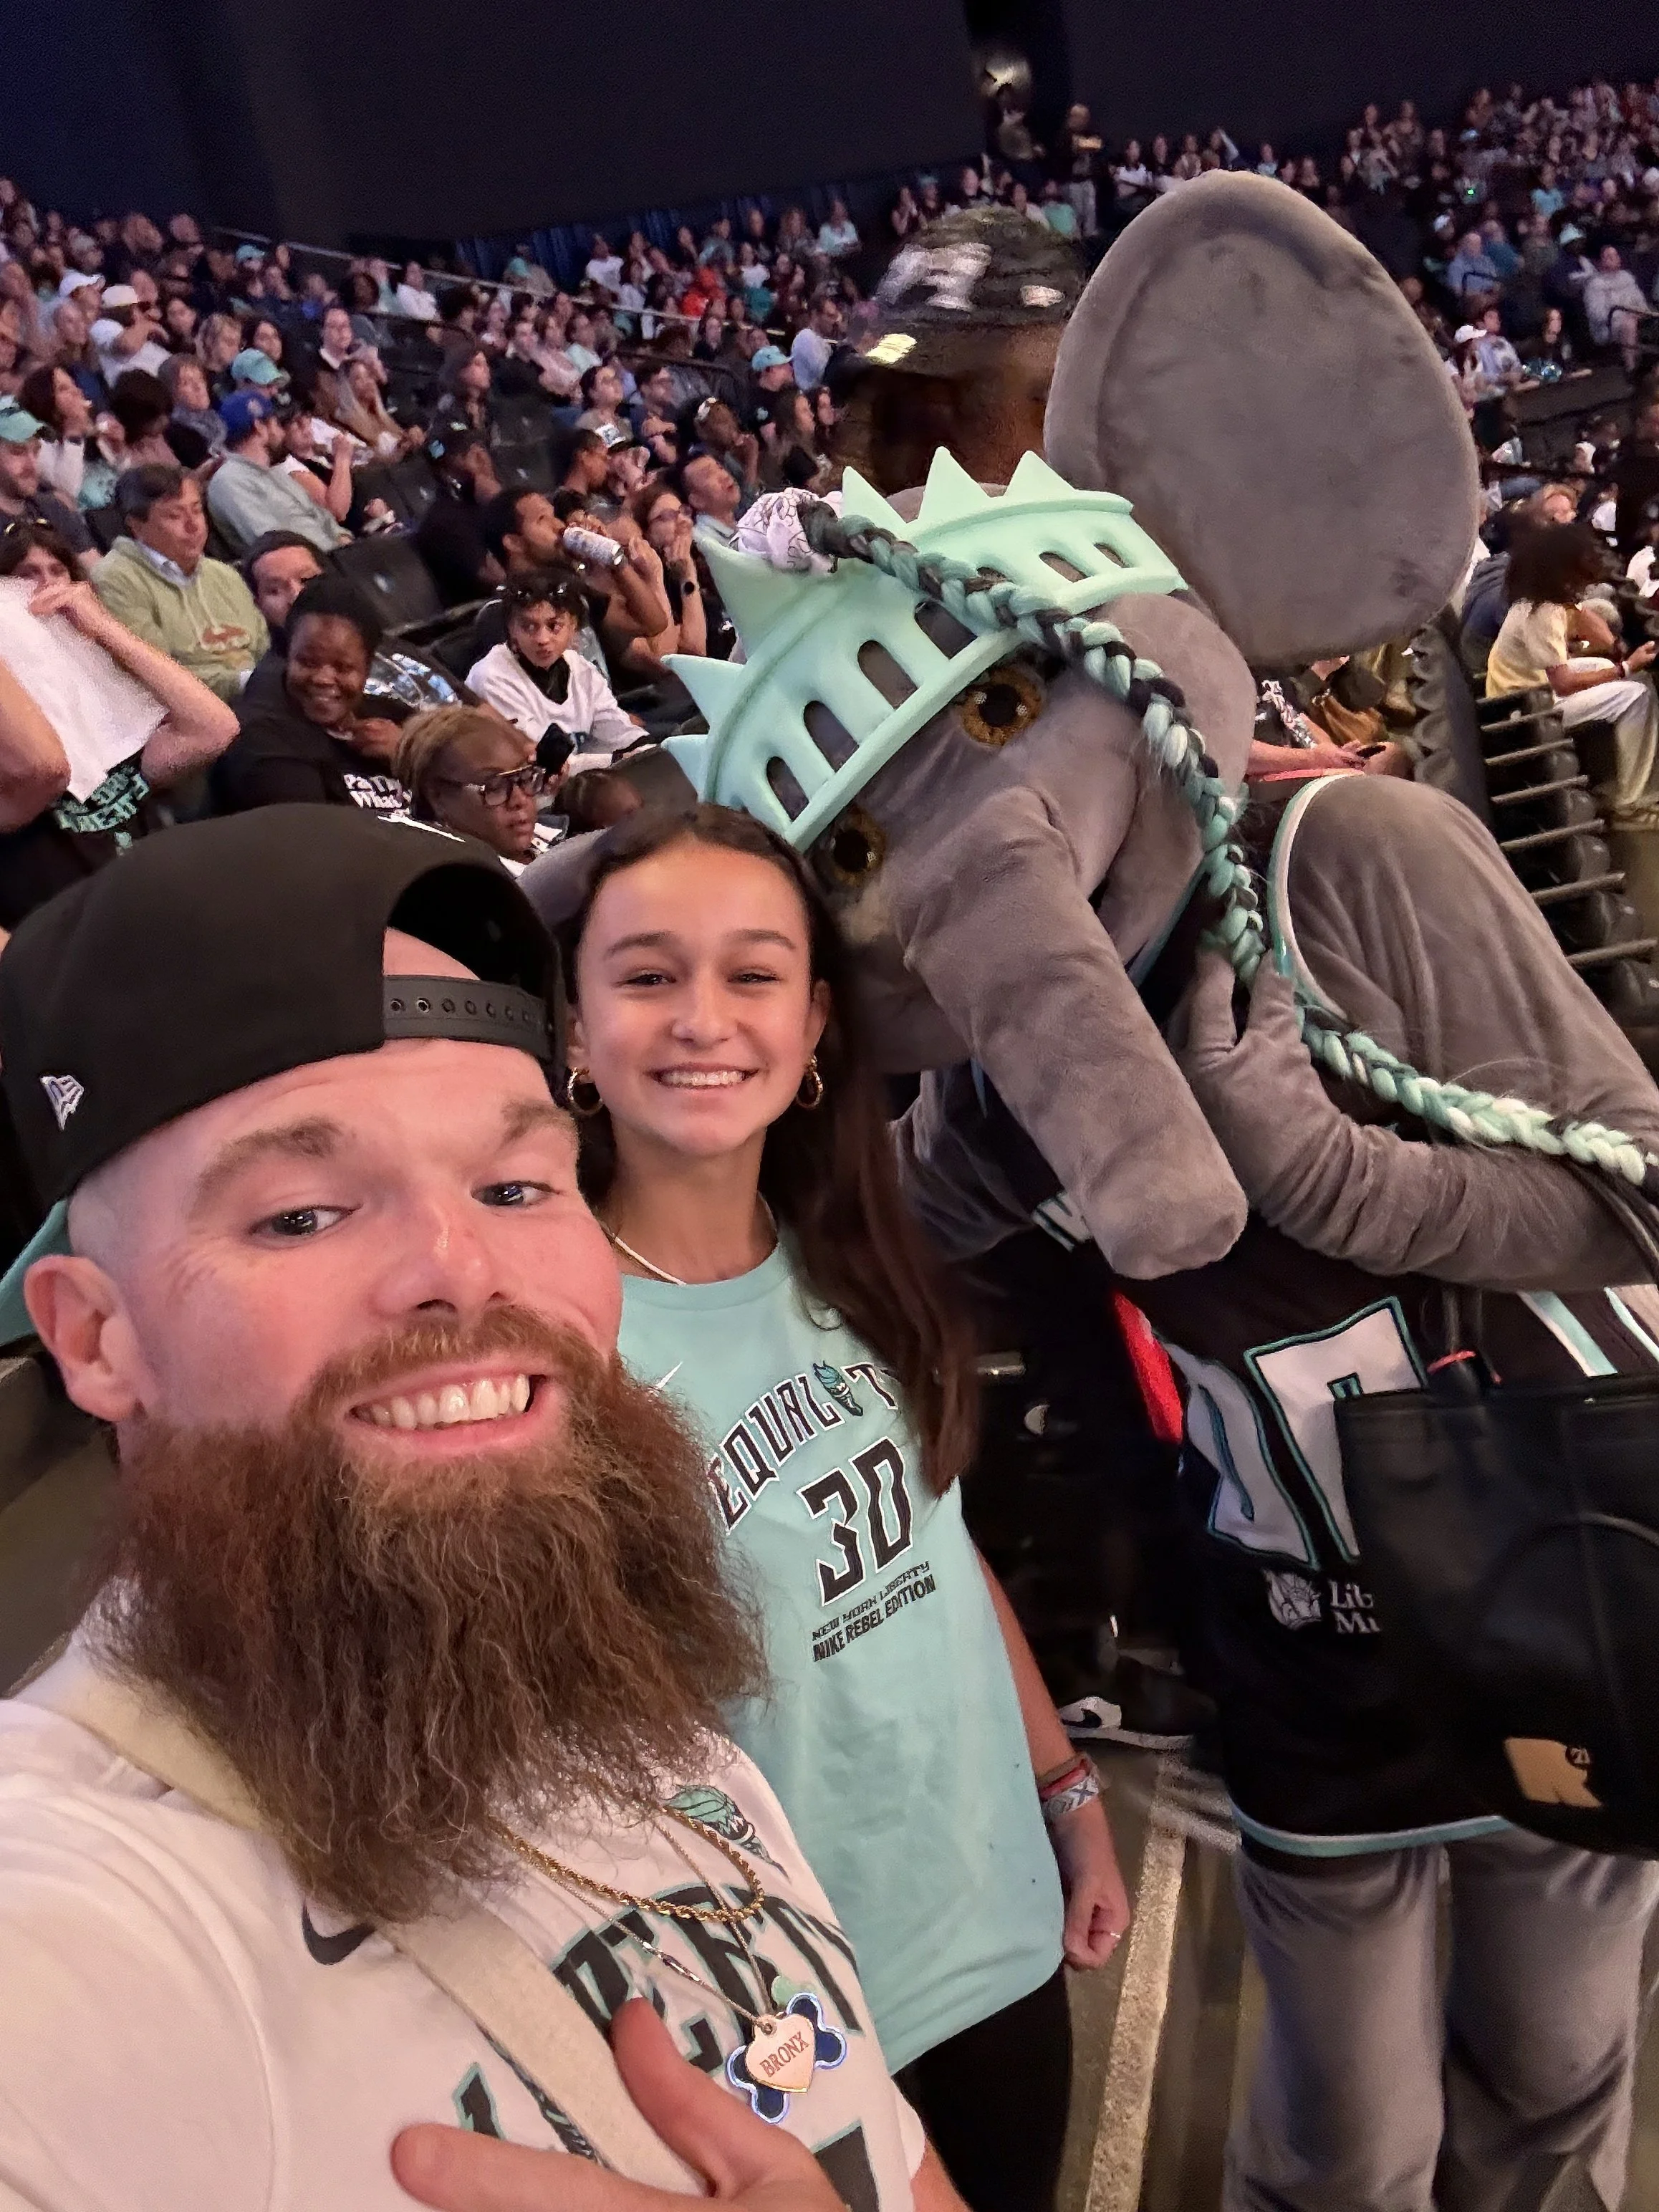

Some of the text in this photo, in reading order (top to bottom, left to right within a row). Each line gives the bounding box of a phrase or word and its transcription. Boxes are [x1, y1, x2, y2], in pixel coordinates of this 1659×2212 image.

[796, 1437, 913, 1607] 30
[812, 1560, 930, 1640] NEW YORK LIBERTY
[812, 1574, 936, 1663] NIKE REBEL EDITION
[1327, 1577, 1374, 1609] Lib
[759, 2031, 809, 2077] BRONX
